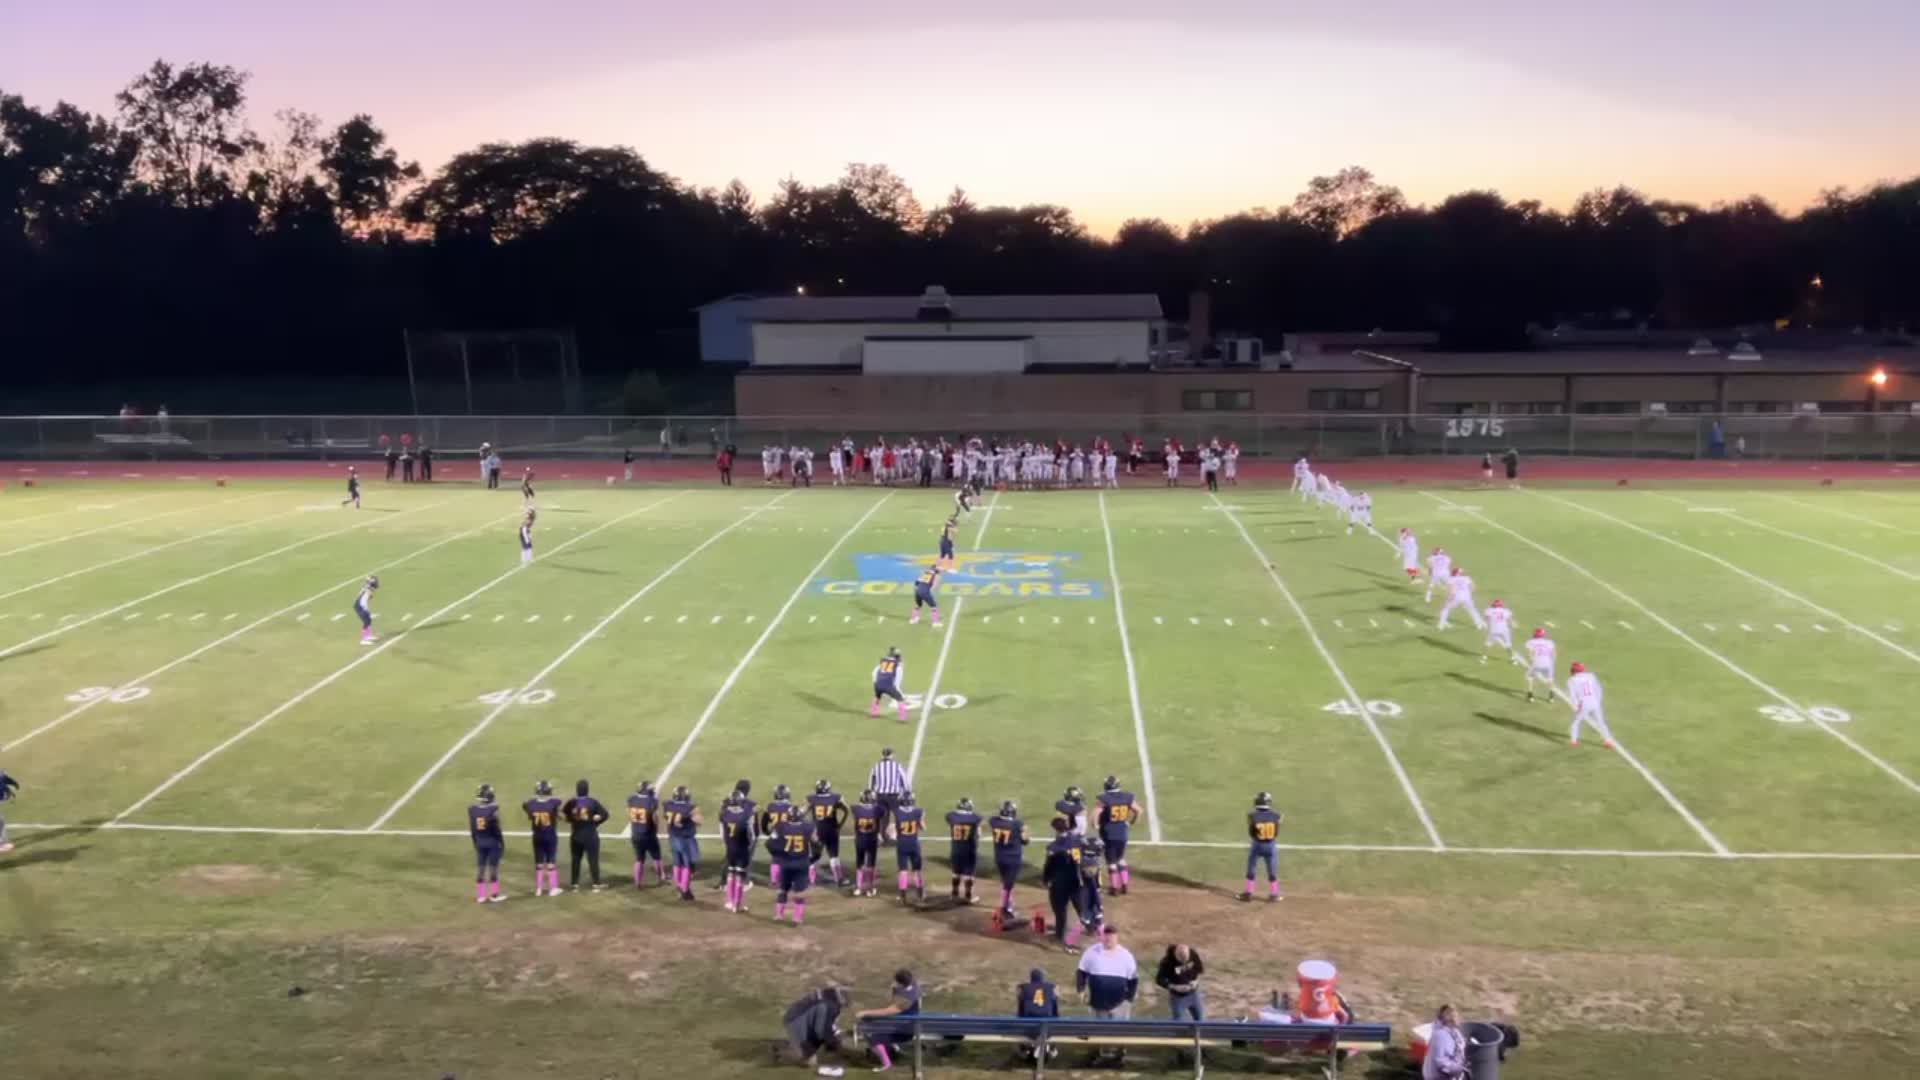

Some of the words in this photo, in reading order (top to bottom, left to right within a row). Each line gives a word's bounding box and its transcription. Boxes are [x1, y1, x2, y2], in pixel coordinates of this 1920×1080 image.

[477, 688, 556, 704] 40
[1321, 699, 1403, 715] 40
[1757, 705, 1851, 722] 30
[783, 834, 805, 852] 75
[1032, 988, 1045, 1007] 4
